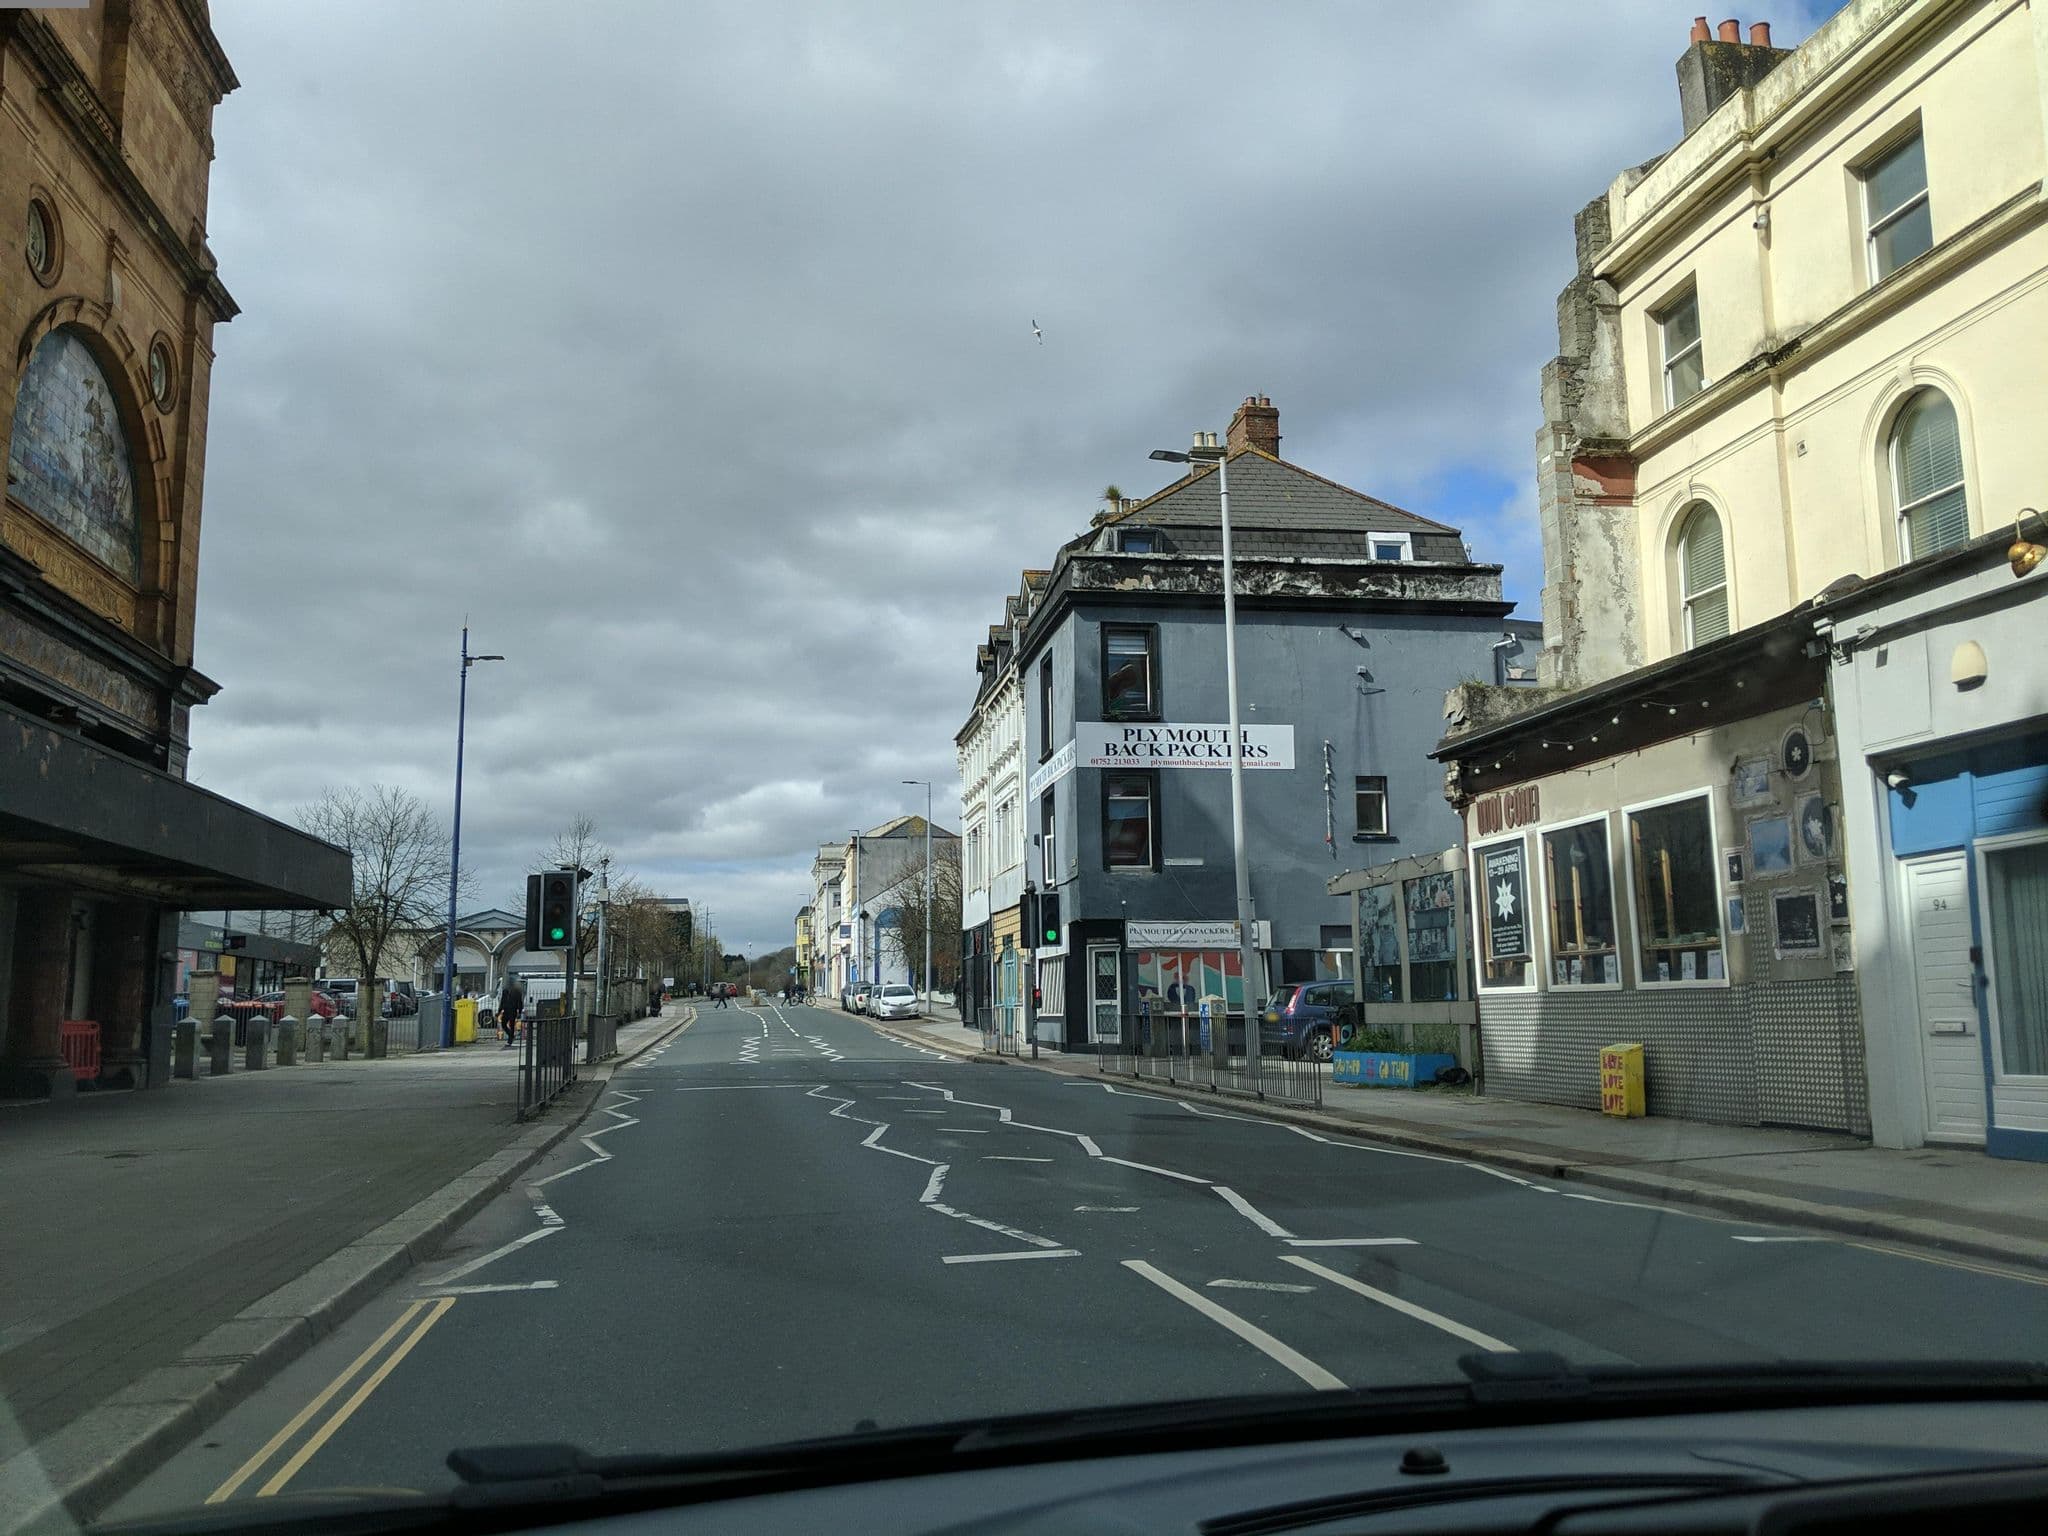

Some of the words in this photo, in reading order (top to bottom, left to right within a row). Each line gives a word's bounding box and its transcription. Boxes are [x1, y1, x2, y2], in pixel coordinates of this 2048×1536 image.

[1123, 728, 1248, 743] PLYMOUTH
[1114, 758, 1140, 766] 213033
[1933, 898, 1947, 911] 94
[1603, 1094, 1624, 1112] LOVE
